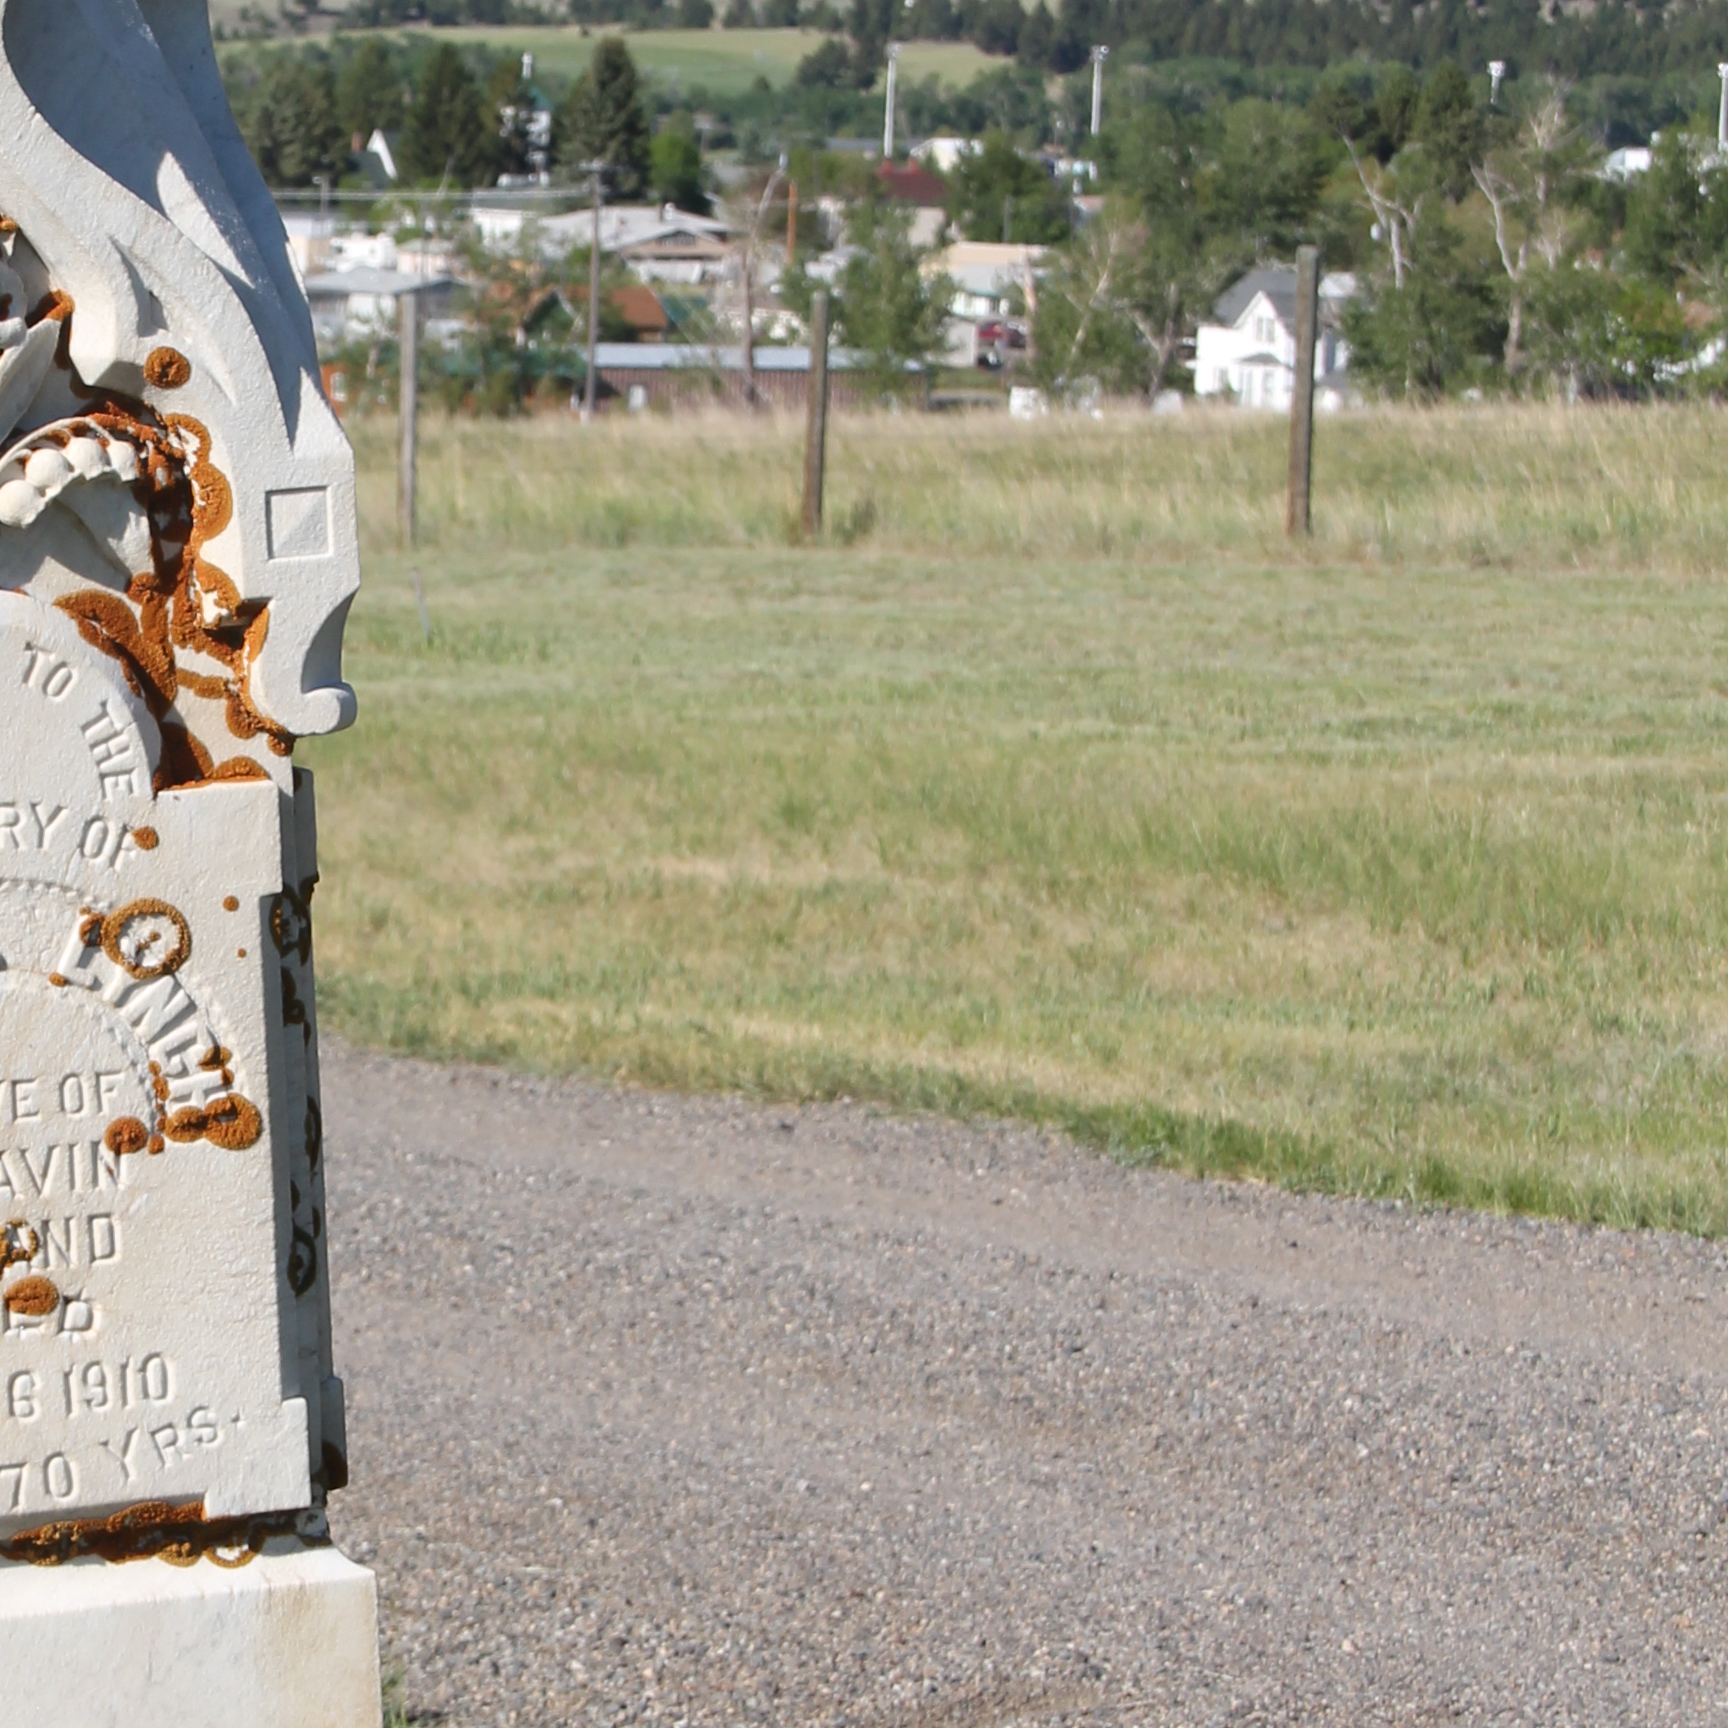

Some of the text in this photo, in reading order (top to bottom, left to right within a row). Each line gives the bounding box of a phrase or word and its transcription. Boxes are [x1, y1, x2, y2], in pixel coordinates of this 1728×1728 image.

[22, 639, 78, 703] TO
[80, 698, 142, 804] THE
[78, 814, 148, 872] OF
[58, 1069, 126, 1120] OF
[64, 1349, 176, 1418] 1910
